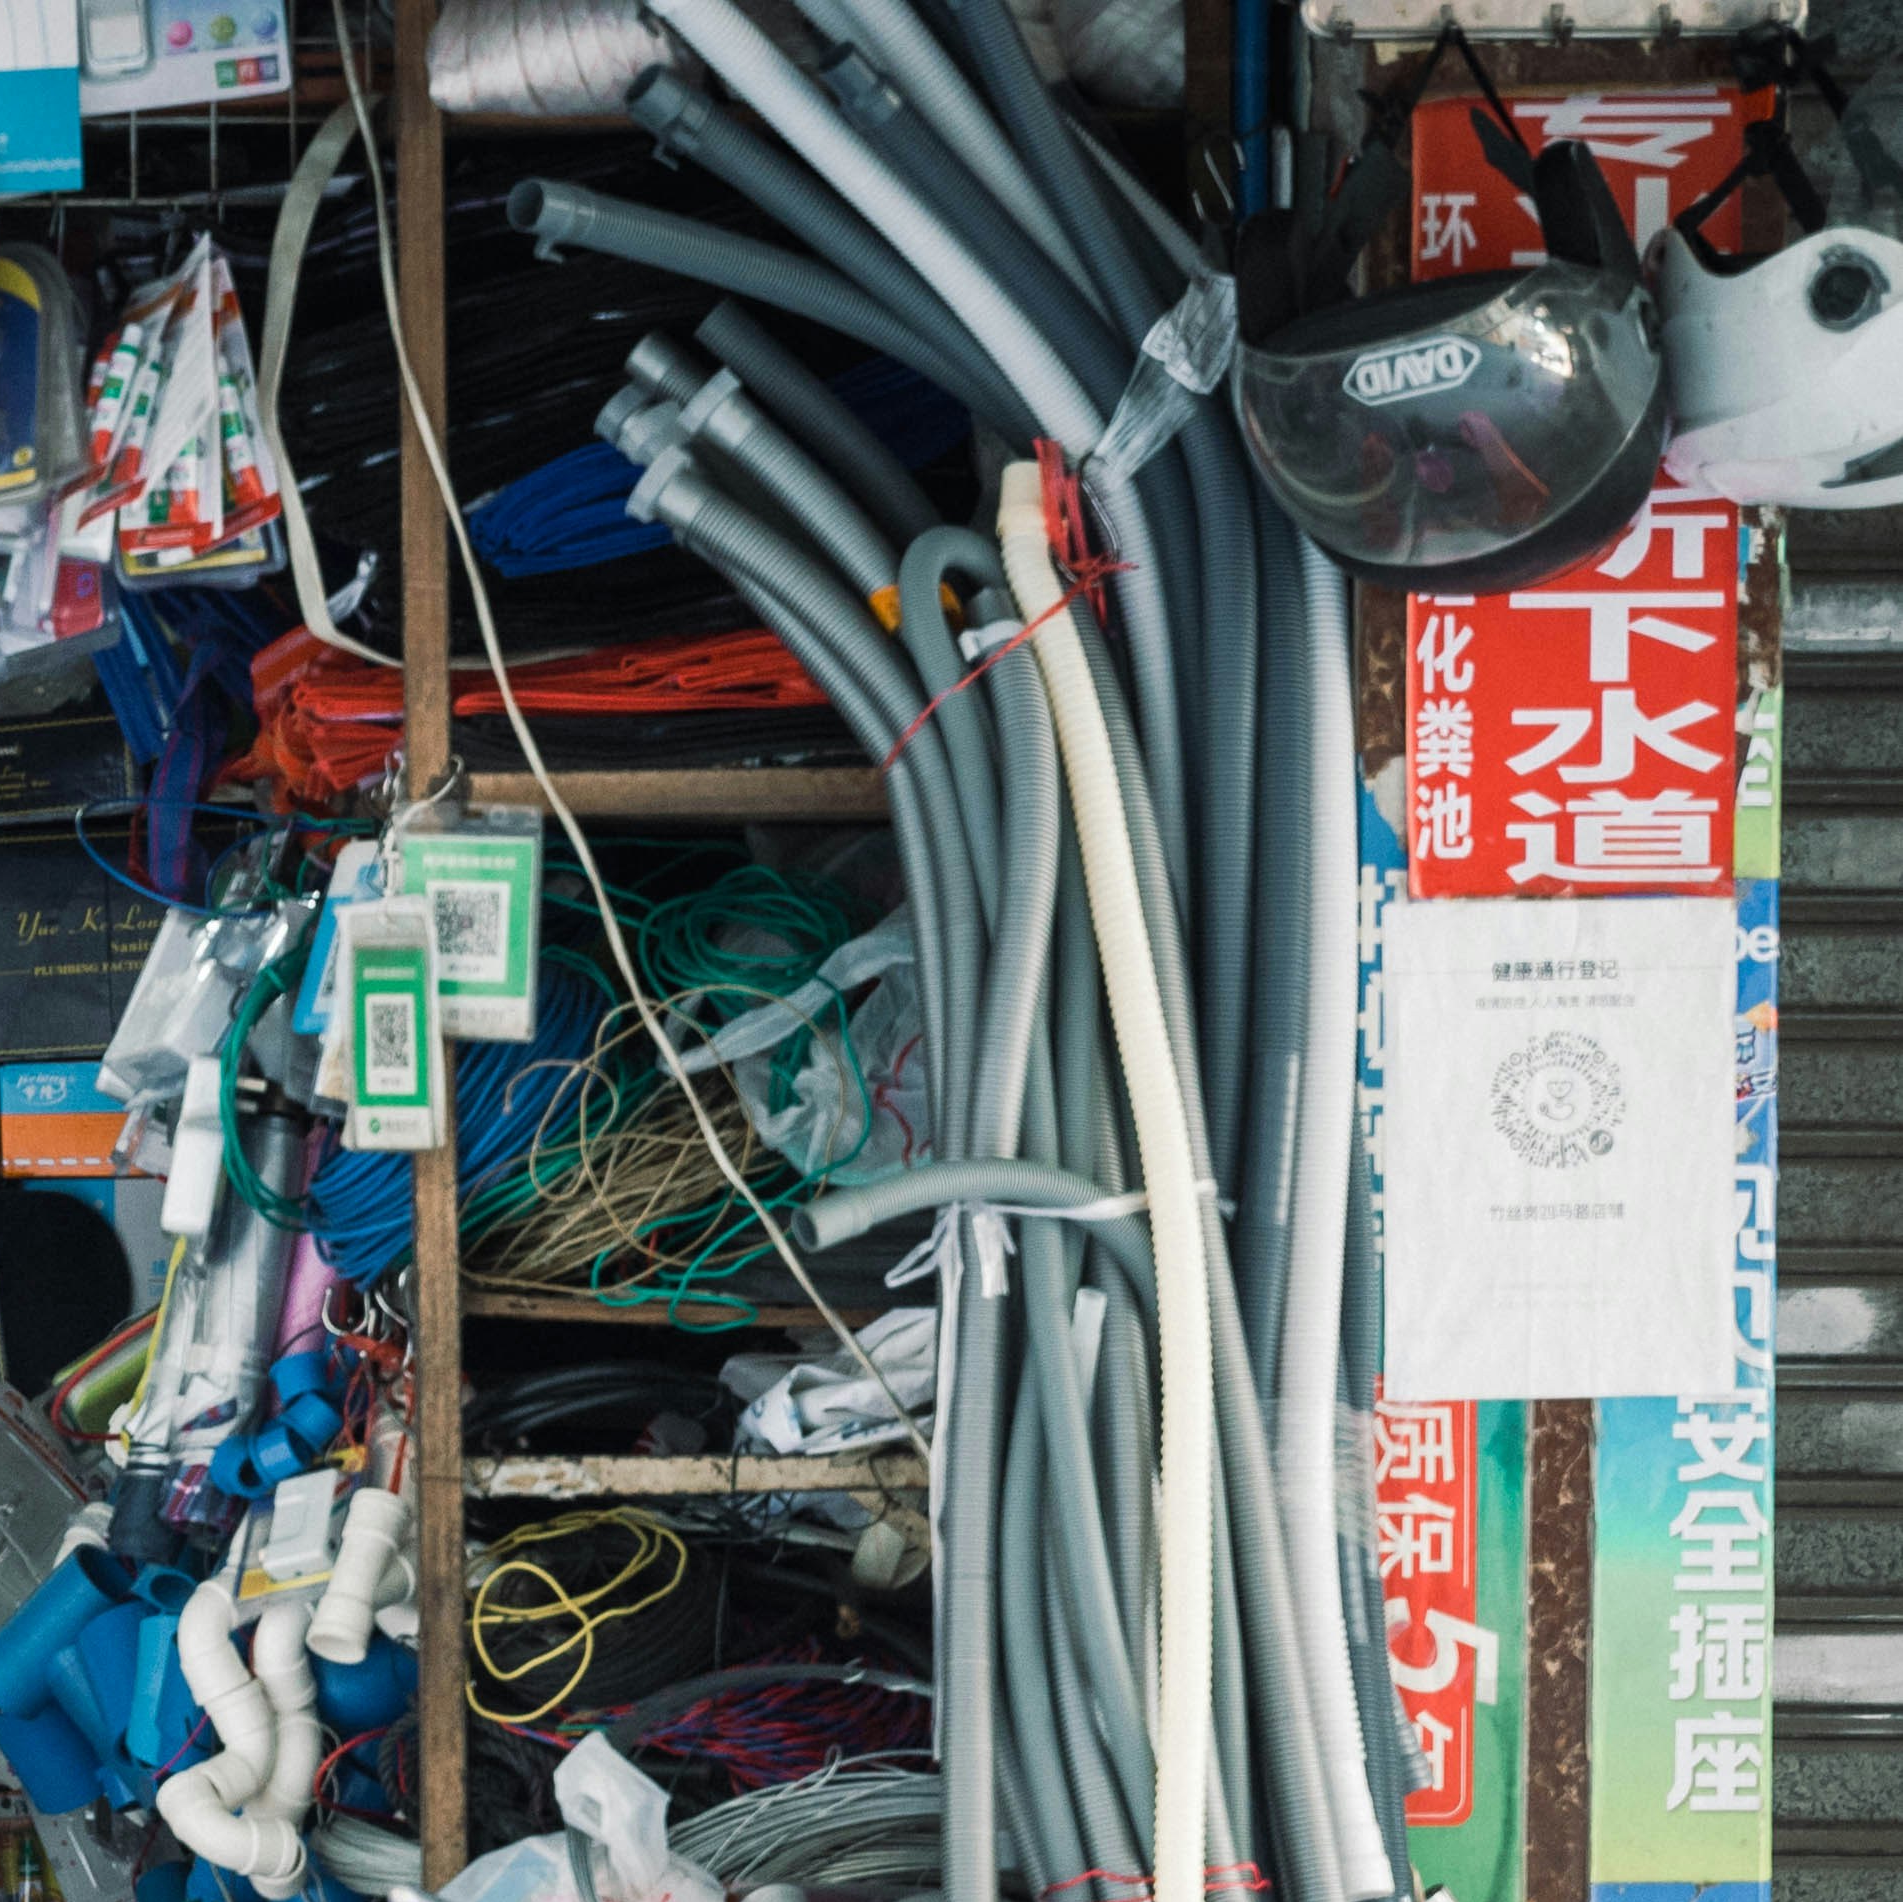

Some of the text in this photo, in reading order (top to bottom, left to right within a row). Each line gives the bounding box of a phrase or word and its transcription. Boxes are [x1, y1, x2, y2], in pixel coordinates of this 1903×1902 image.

[1356, 343, 1466, 397] DAVID
[1492, 959, 1619, 982] 健康通行登记
[1666, 1388, 1771, 1813] 安全插座
